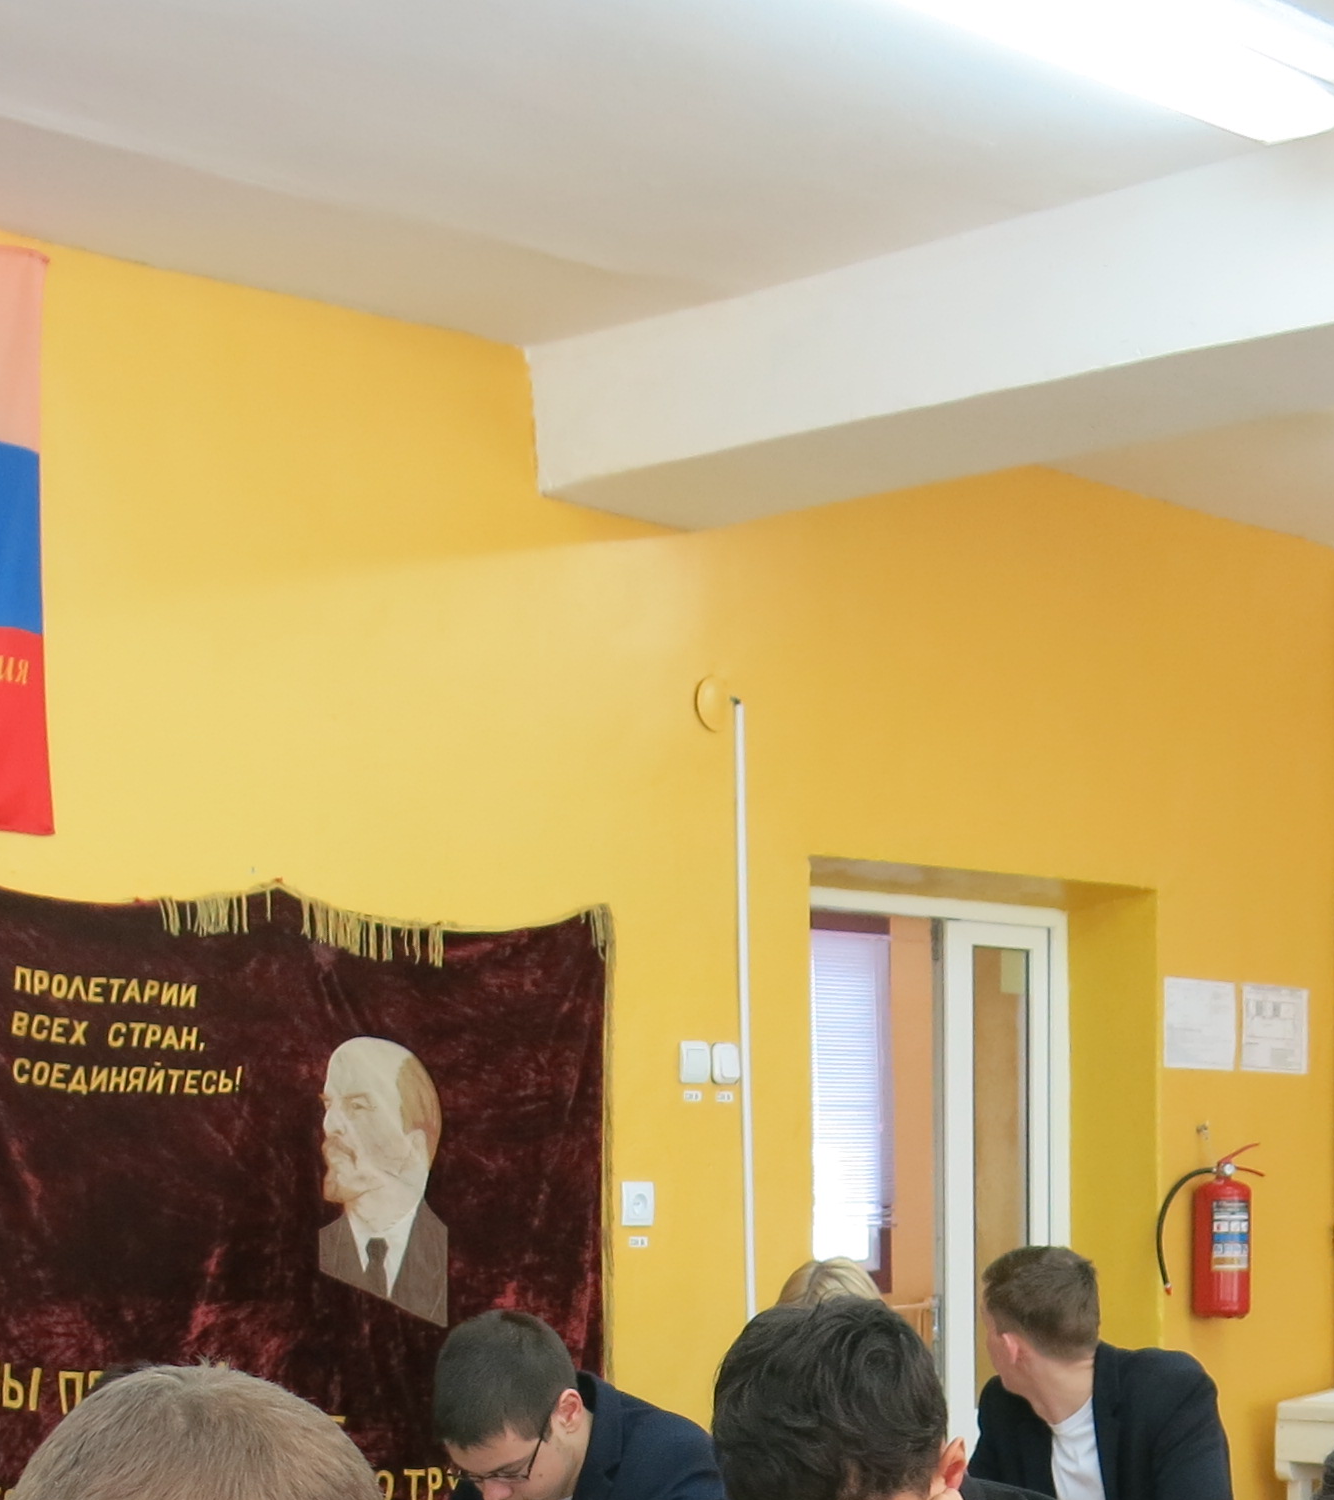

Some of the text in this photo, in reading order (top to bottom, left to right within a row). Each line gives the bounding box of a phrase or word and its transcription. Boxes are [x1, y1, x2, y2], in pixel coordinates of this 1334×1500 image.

[14, 965, 197, 1008] ПРОЛЕТАРИИ
[11, 1010, 206, 1053] ВСЕХ СТРАН,
[12, 1056, 243, 1096] СОЕДИНЯЙТЕСЬ!
